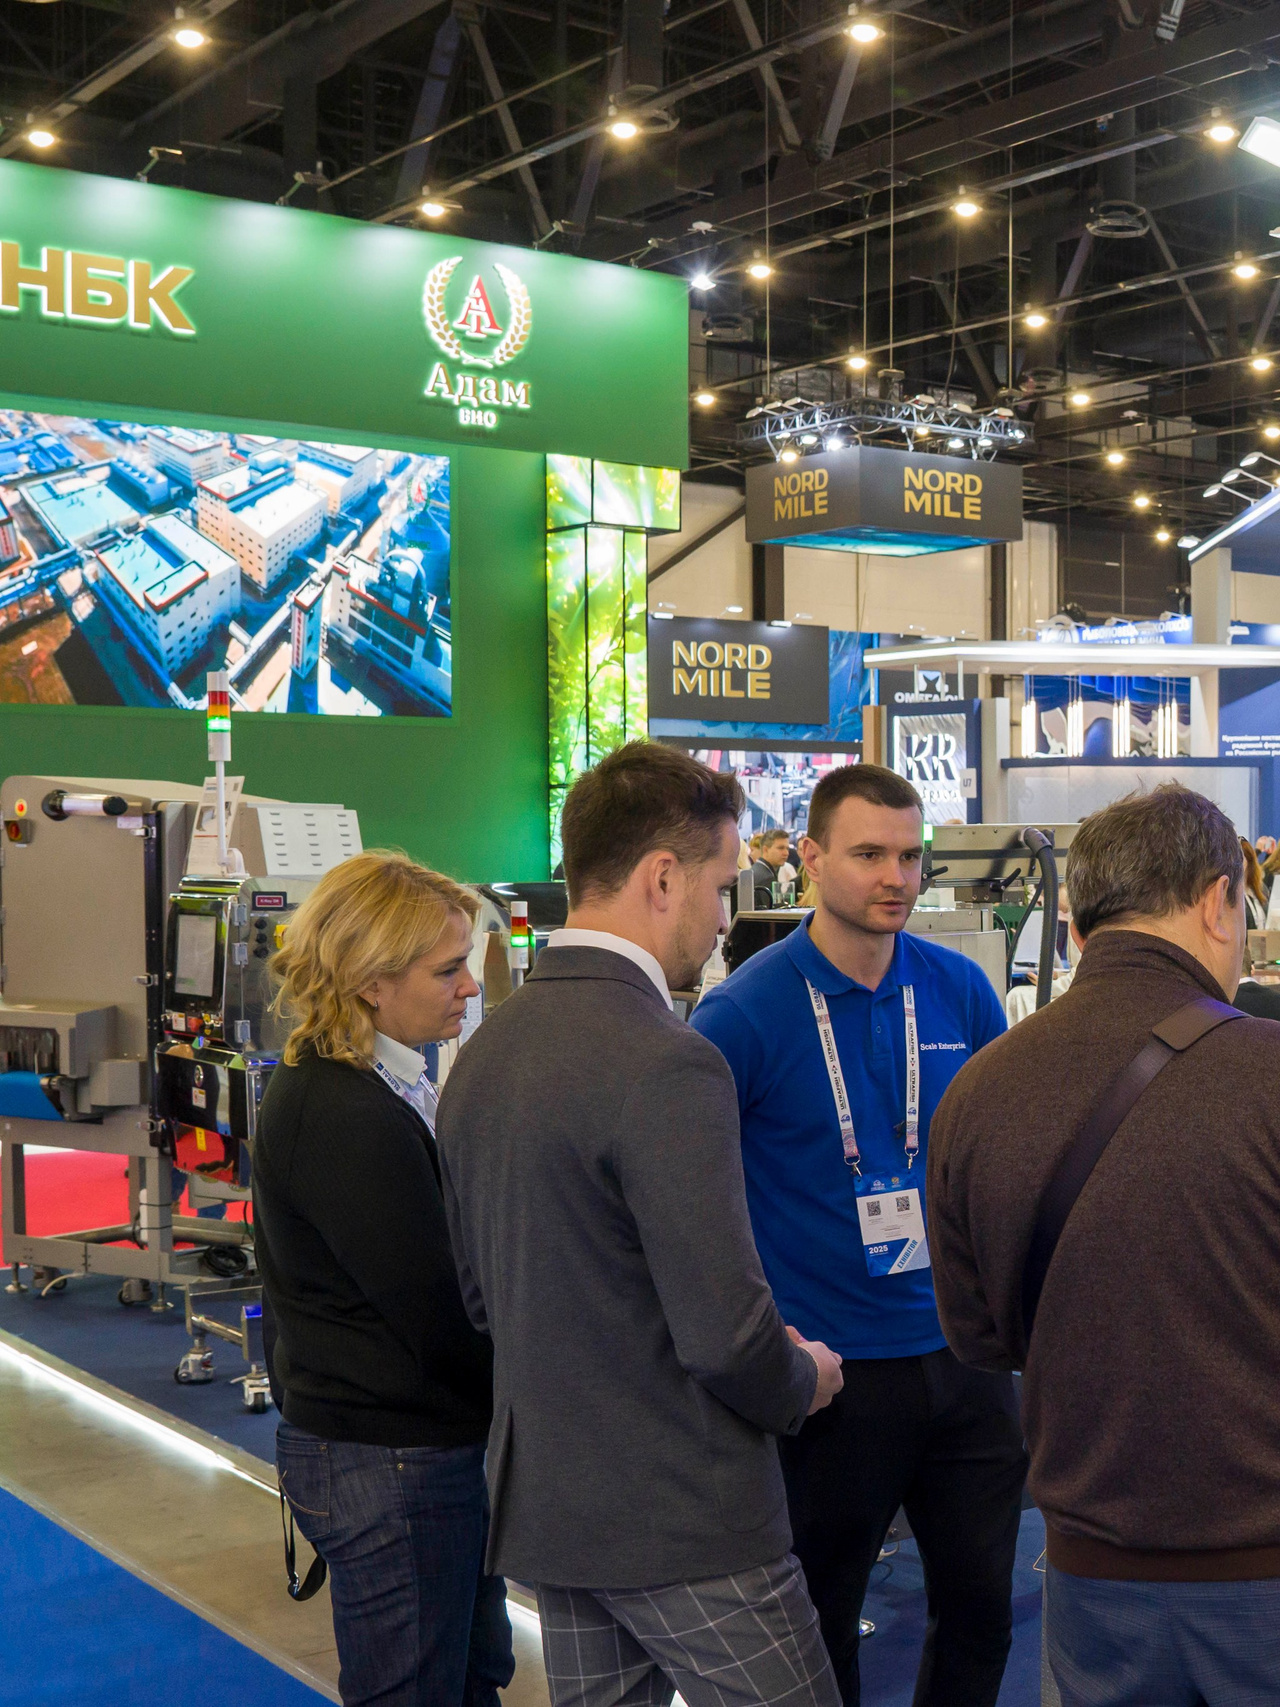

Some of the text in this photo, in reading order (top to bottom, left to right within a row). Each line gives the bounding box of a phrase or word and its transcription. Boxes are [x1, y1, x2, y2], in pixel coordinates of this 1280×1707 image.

[0, 241, 196, 335] НБК
[424, 362, 531, 408] Адам
[774, 468, 829, 498] NORD
[904, 466, 983, 496] NORD
[774, 490, 829, 522] MILE
[904, 489, 982, 520] MILE
[673, 640, 772, 669] NORD
[673, 668, 771, 699] MILE
[962, 778, 972, 788] U7
[823, 1029, 834, 1062] ULTRAFISH
[920, 1043, 937, 1051] Scale
[834, 1076, 845, 1110] ULTRAFISH
[868, 1244, 889, 1254] 2025
[897, 1239, 918, 1269] EXHIBITOR
